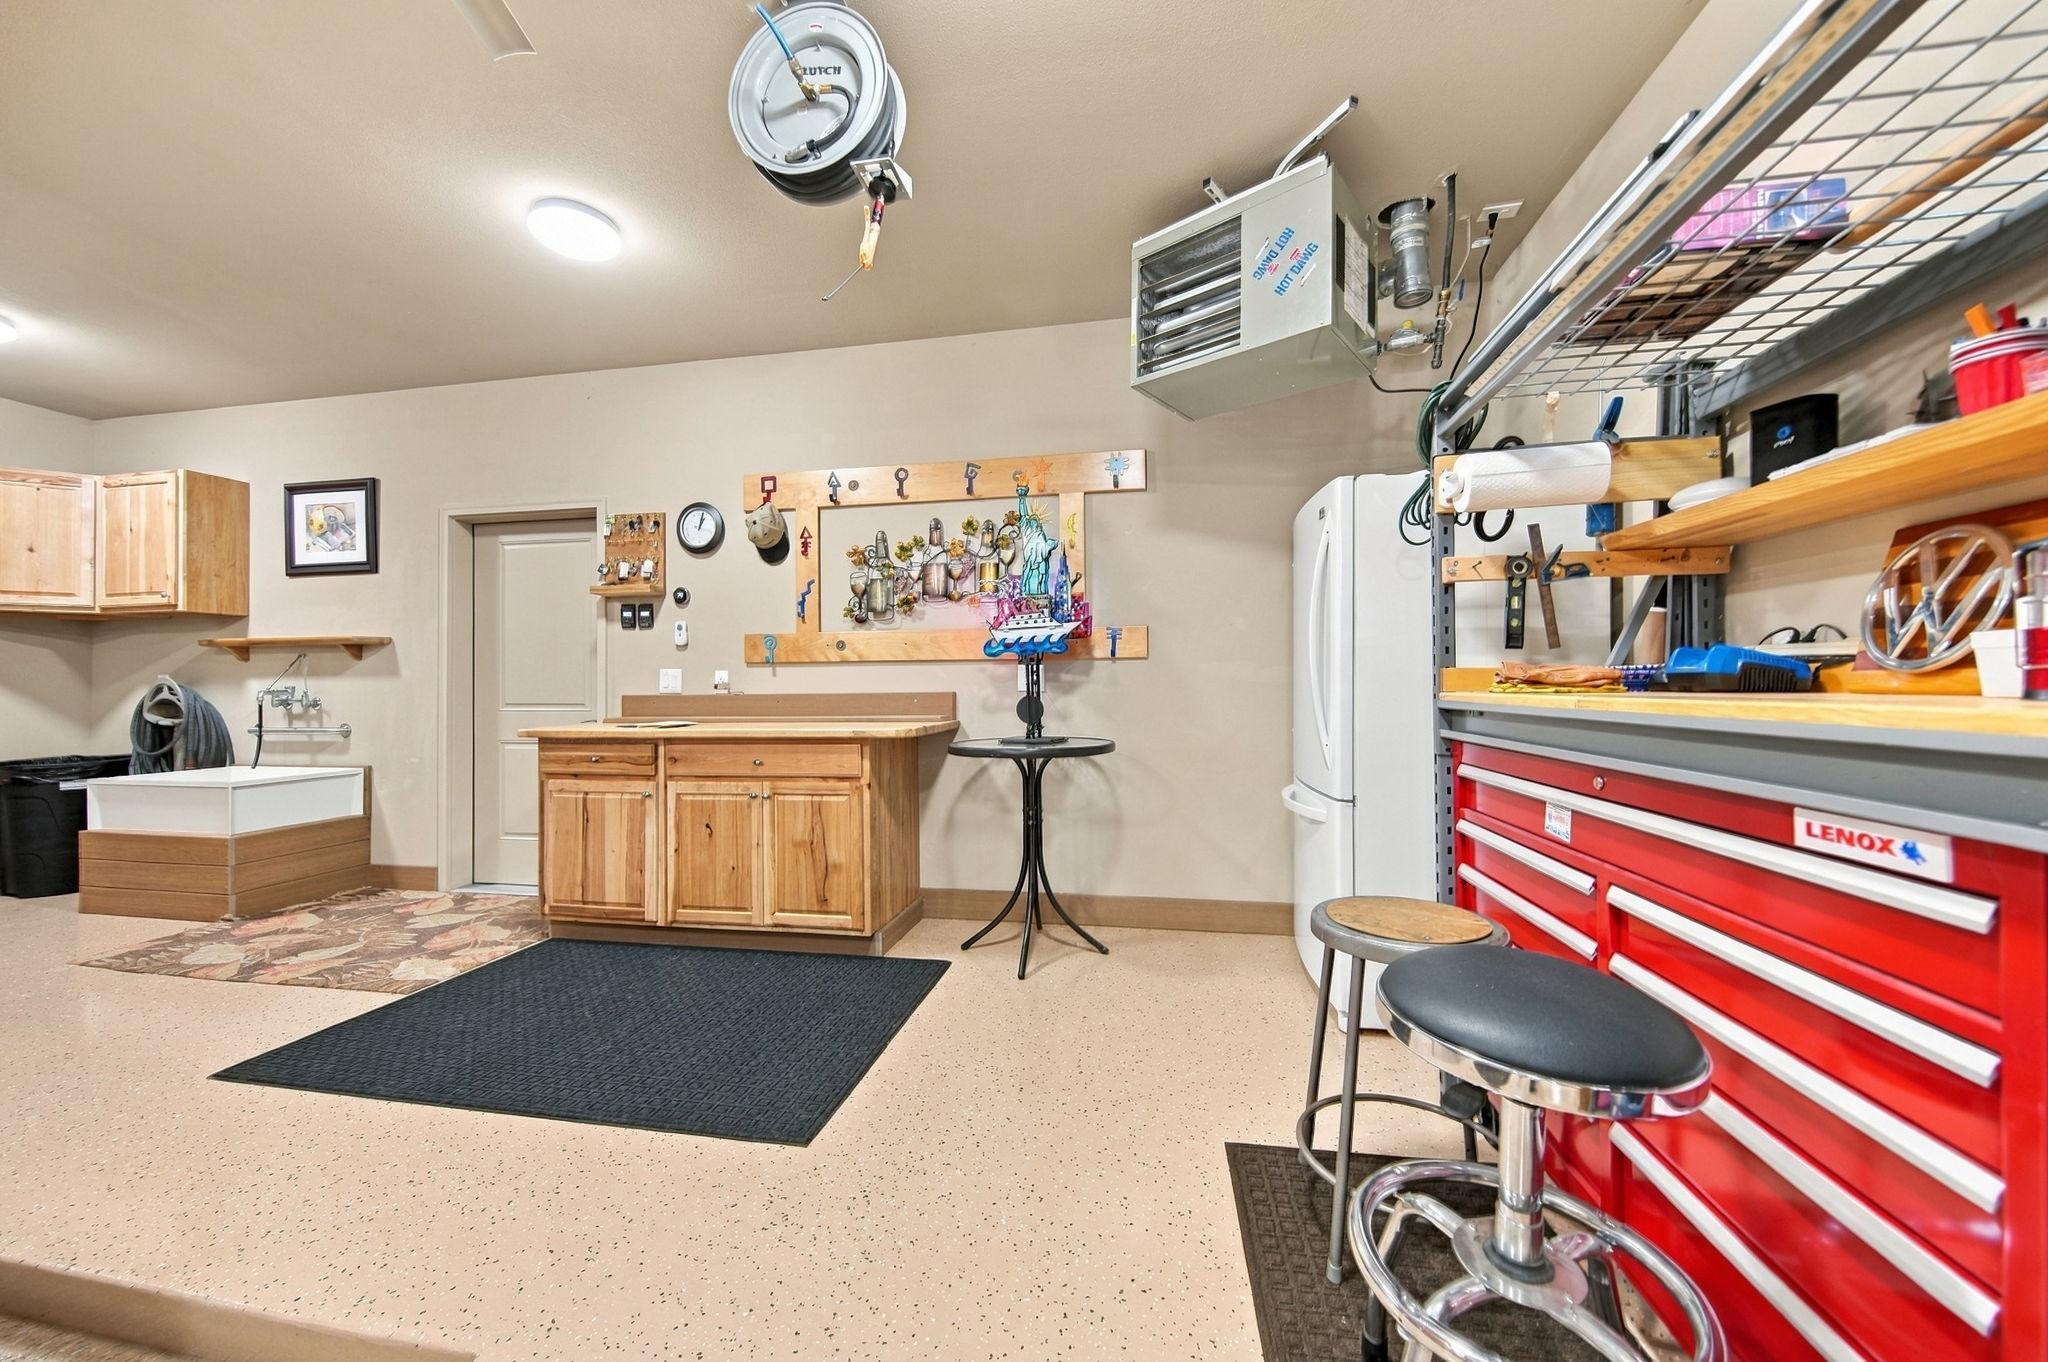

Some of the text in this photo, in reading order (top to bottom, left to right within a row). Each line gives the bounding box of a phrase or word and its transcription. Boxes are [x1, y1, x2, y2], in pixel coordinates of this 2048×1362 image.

[1252, 227, 1295, 280] HOT DAWG
[1274, 242, 1319, 296] HOT DAWG
[1805, 821, 1897, 857] LENOX
